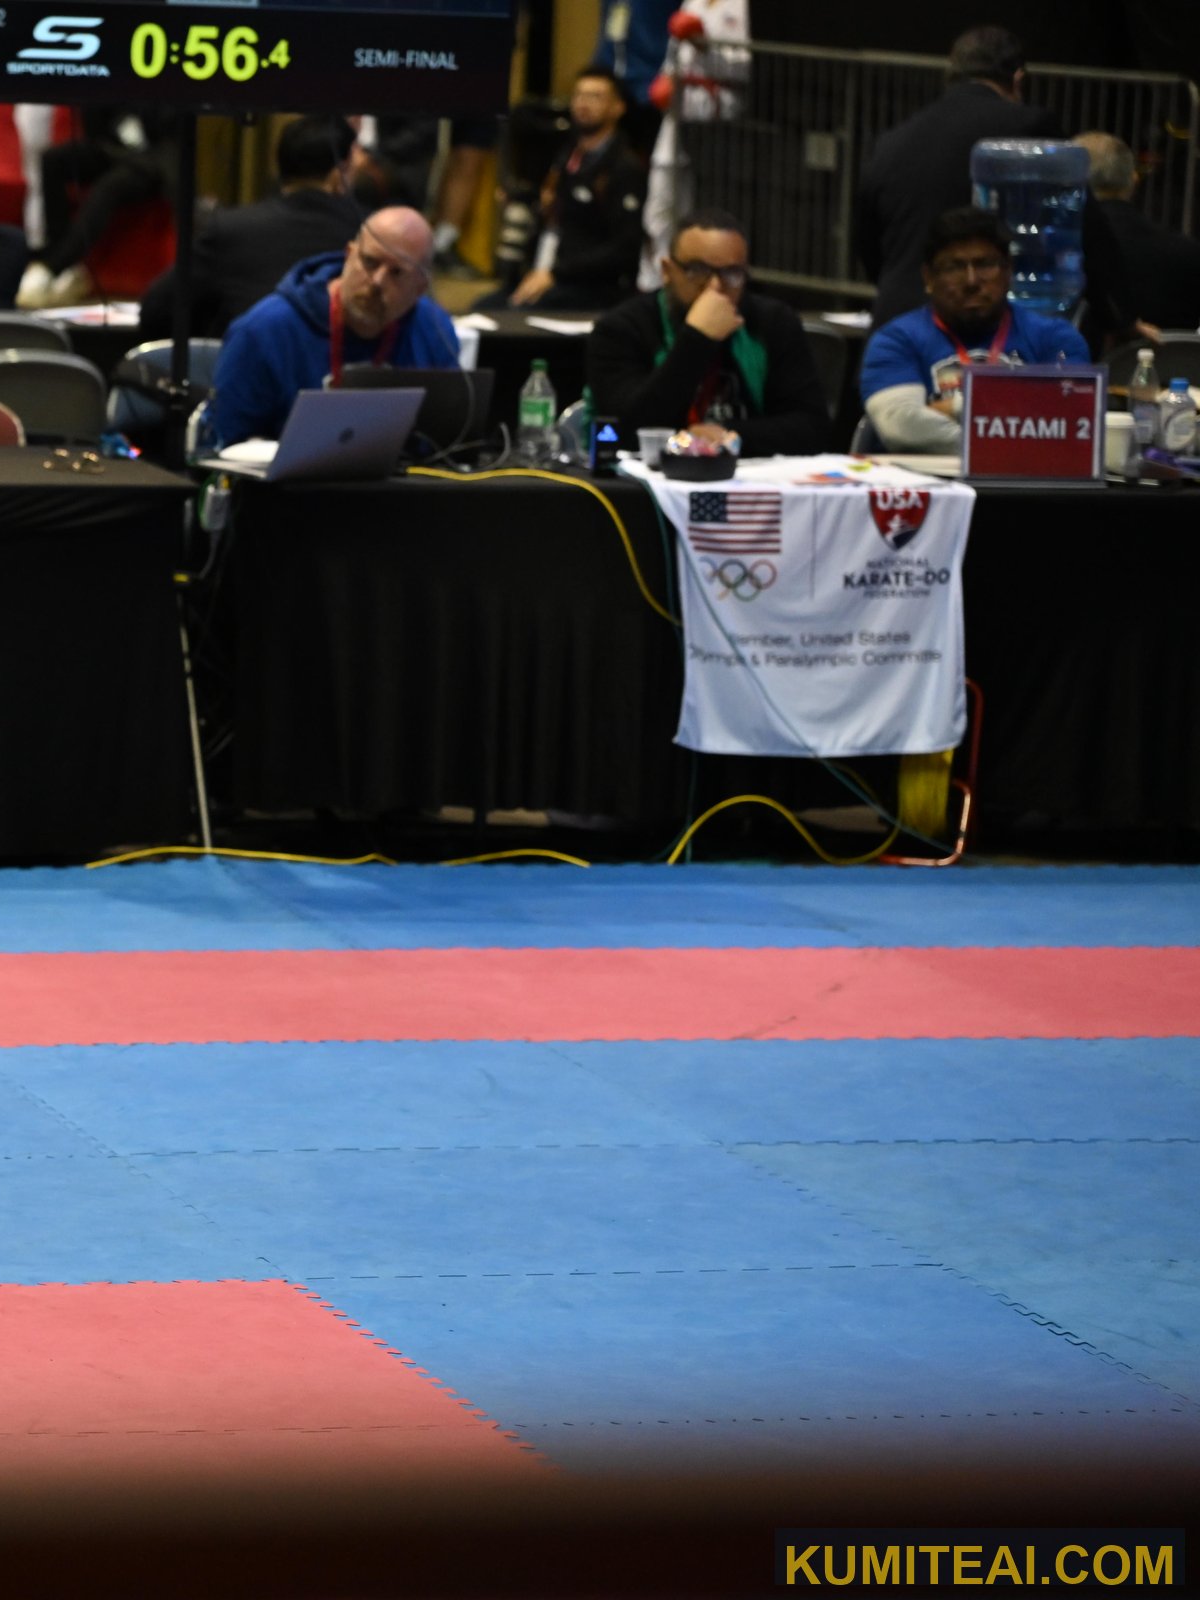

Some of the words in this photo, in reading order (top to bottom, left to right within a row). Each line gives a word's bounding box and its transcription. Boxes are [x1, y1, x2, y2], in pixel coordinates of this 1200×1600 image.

[130, 23, 290, 81] 0:56.4
[354, 48, 459, 70] SEMI-FINAL
[6, 62, 110, 77] SPORTDATA
[974, 415, 1067, 440] TATAMI
[1076, 416, 1091, 440] 2
[843, 567, 951, 590] KARATE-DO
[800, 632, 853, 646] United
[858, 631, 912, 647] States
